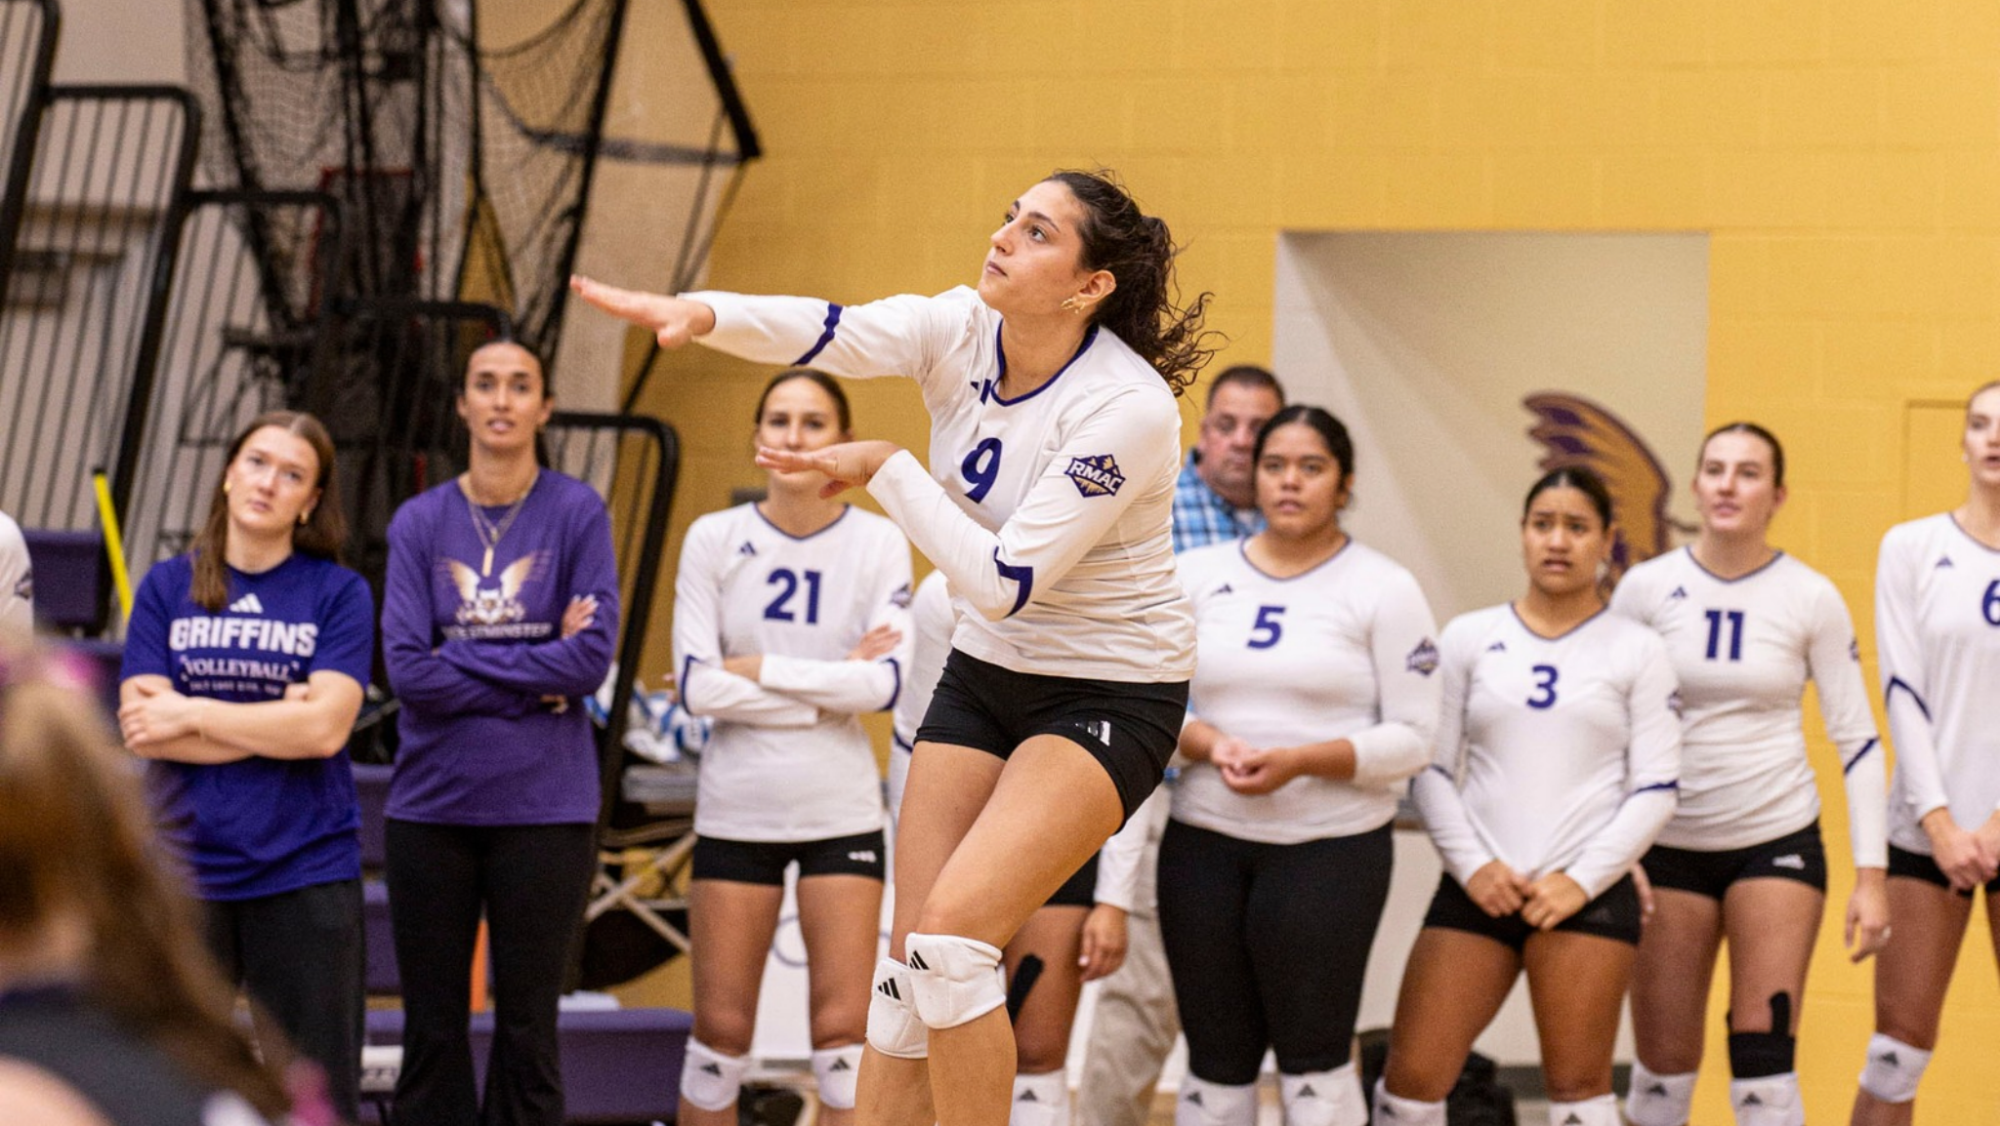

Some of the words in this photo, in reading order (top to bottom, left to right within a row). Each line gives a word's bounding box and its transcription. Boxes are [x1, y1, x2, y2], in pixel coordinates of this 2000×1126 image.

[961, 437, 1002, 504] 9
[1068, 460, 1123, 493] RMAC
[764, 570, 821, 623] 21
[1982, 579, 2000, 627] 6
[169, 616, 319, 657] GRIFFINS
[1246, 605, 1287, 649] 5
[1705, 610, 1744, 660] 11
[184, 658, 292, 682] VOLLEYBALL
[1527, 665, 1558, 709] 3
